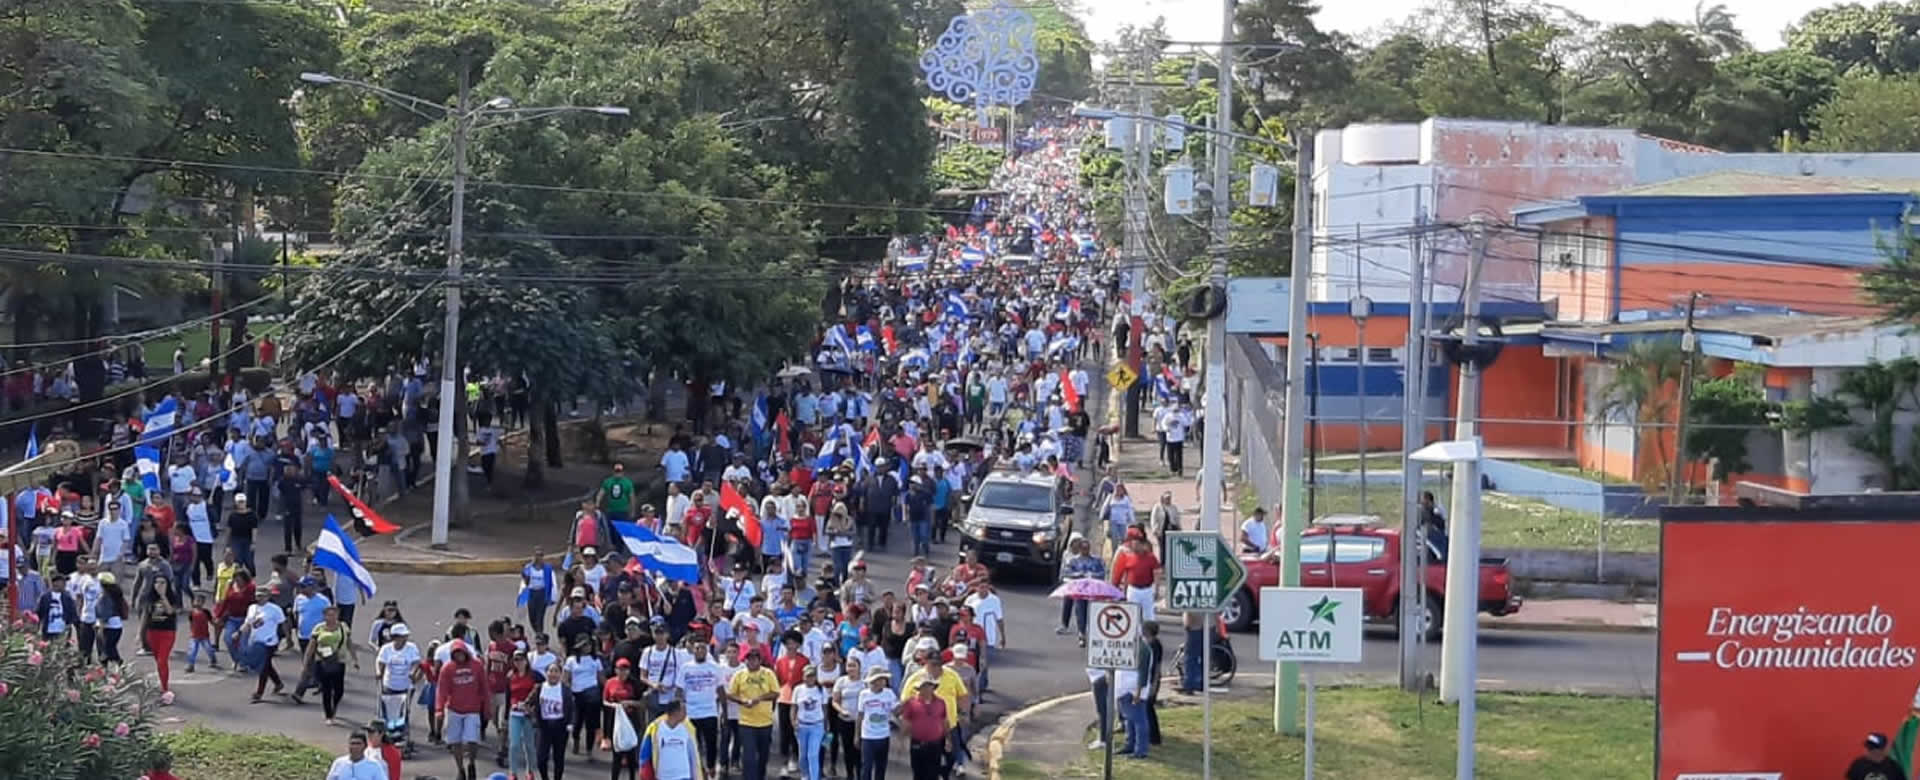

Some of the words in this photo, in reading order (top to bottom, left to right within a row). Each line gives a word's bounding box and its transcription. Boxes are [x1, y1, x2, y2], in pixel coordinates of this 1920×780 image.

[1174, 580, 1217, 596] ATM
[1173, 596, 1217, 609] LAFISE
[1706, 605, 1892, 643] Energizando
[1277, 630, 1331, 649] ATM
[1715, 638, 1916, 668] Comunidades
